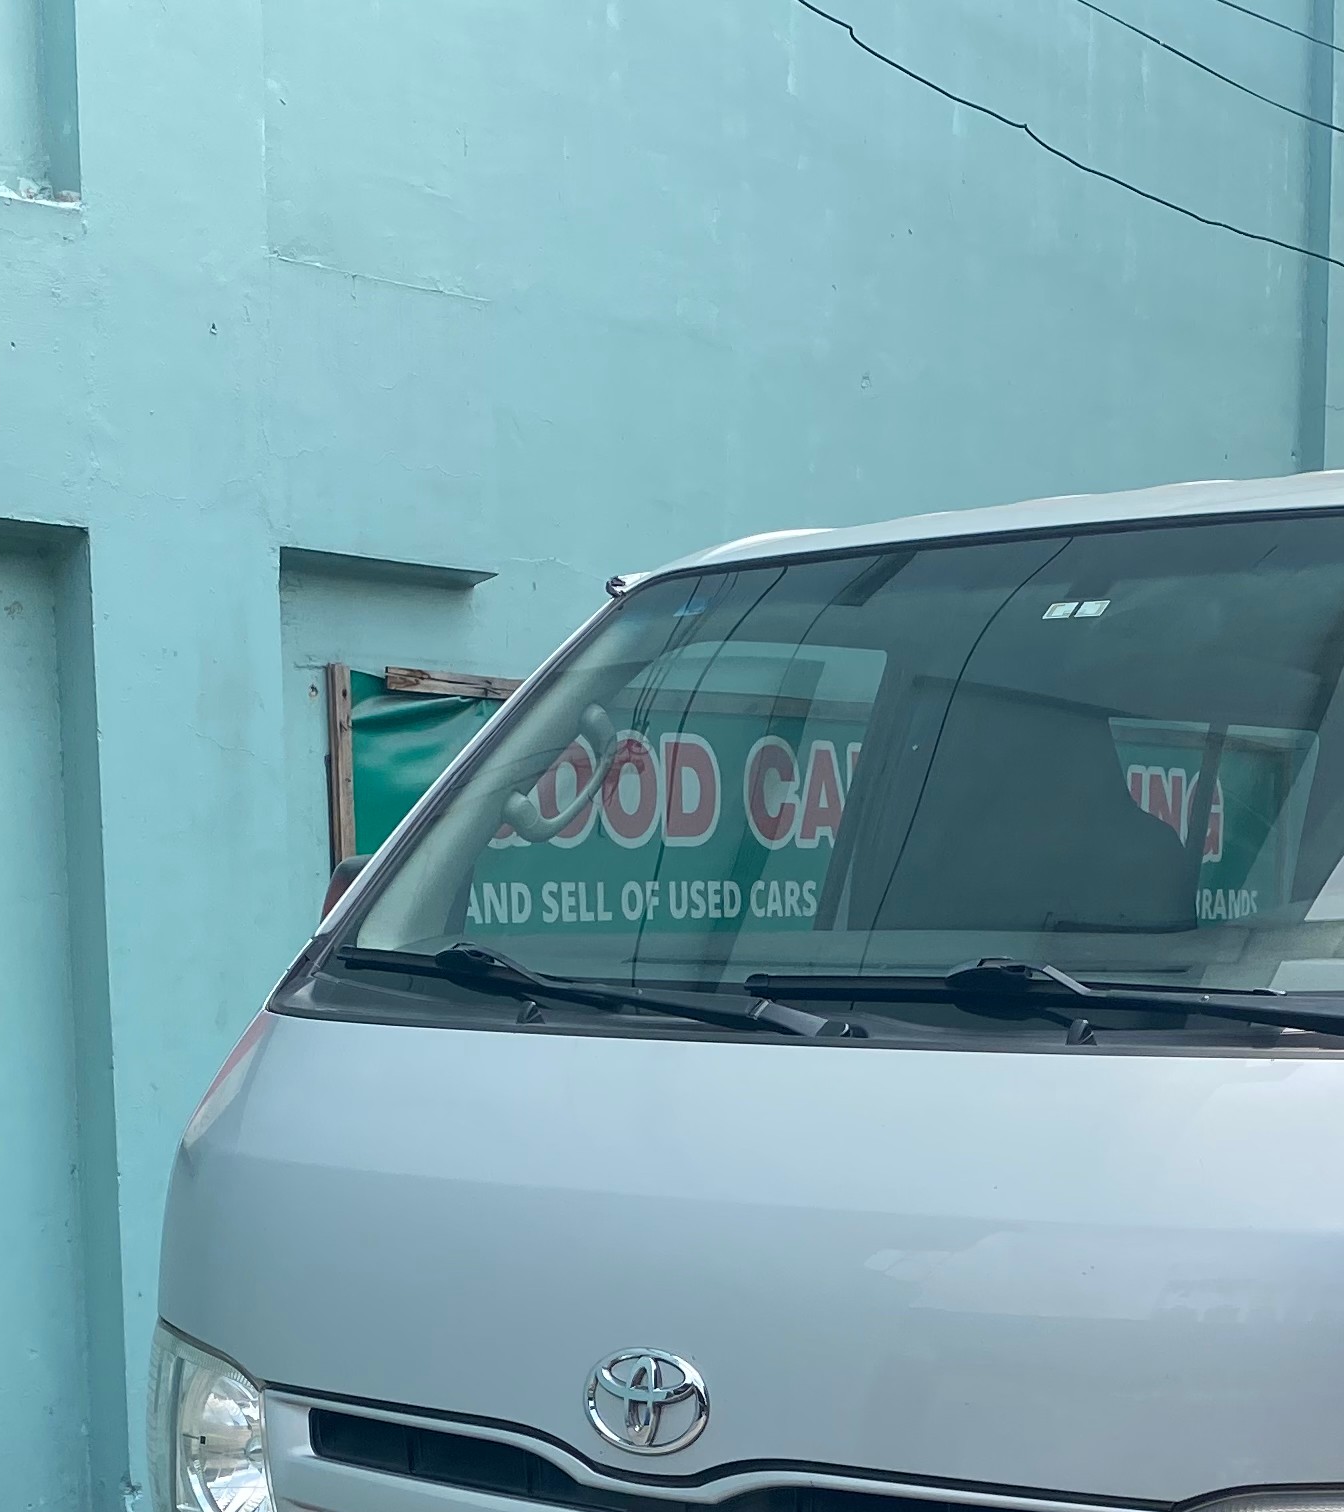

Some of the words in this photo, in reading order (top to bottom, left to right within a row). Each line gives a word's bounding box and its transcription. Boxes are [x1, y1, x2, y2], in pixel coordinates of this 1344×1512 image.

[488, 729, 721, 849] OOD
[541, 880, 613, 923] SELL
[621, 880, 660, 921] OF
[668, 880, 742, 920] USED
[749, 879, 818, 918] CARS
